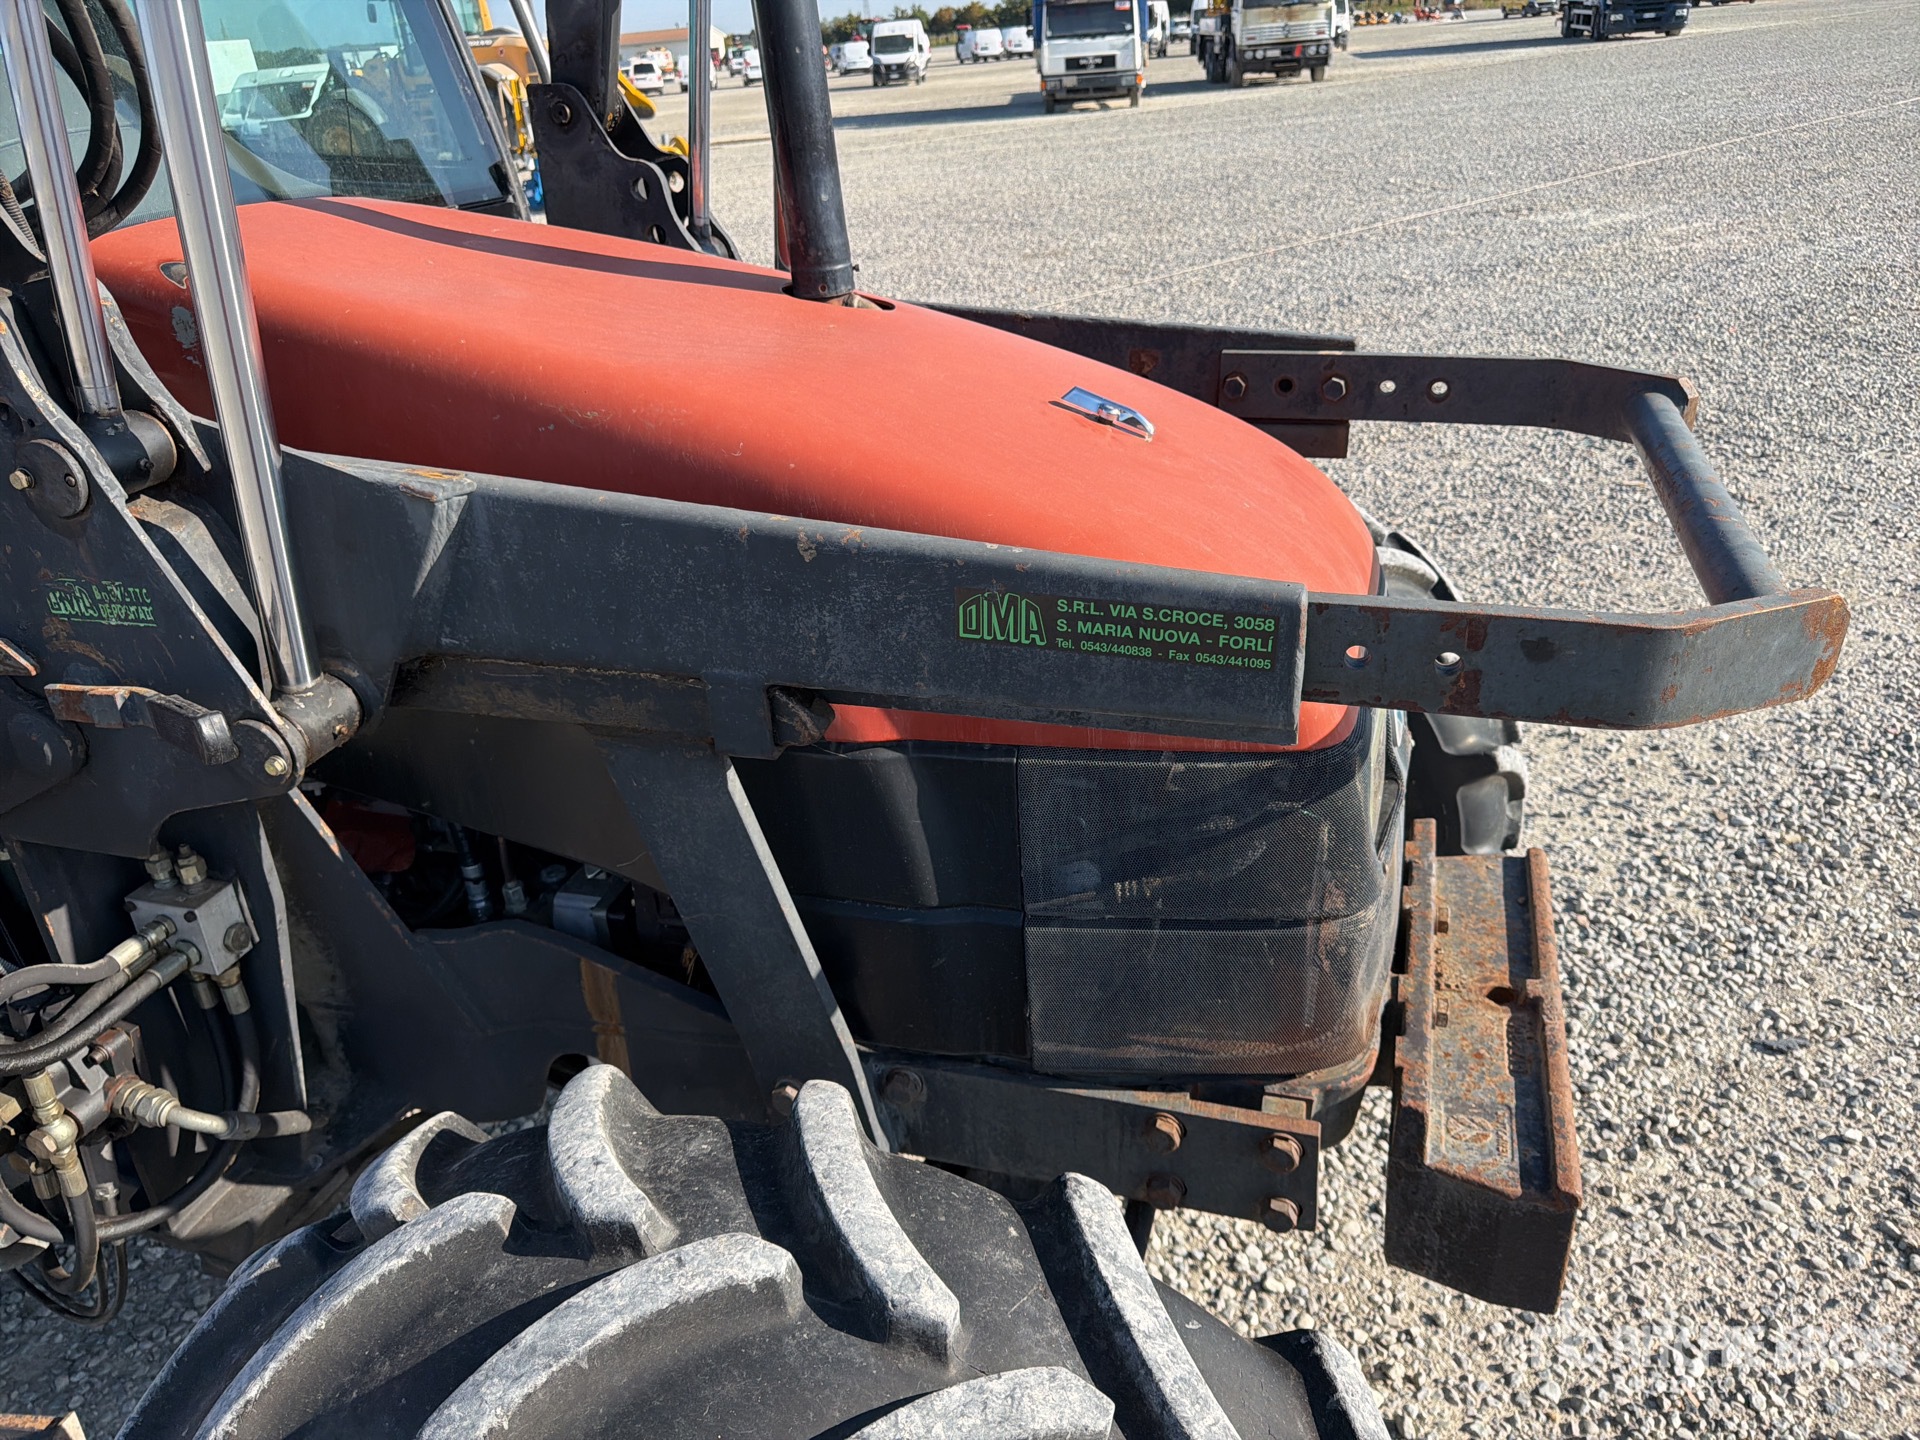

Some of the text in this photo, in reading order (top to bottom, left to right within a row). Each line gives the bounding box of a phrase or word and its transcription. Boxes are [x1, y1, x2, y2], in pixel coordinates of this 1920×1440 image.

[1057, 599, 1275, 632] S.R.L. VIA S.CROCE, 3058
[1057, 619, 1072, 632] S.
[1077, 621, 1133, 639] MARIA
[1139, 627, 1201, 645] NUOVA
[1219, 635, 1274, 652] FORLÍ
[1056, 638, 1075, 649] Tel.
[1081, 641, 1152, 657] 0543/440838
[1169, 650, 1190, 661] Fax
[1195, 653, 1271, 670] 0543/441095
